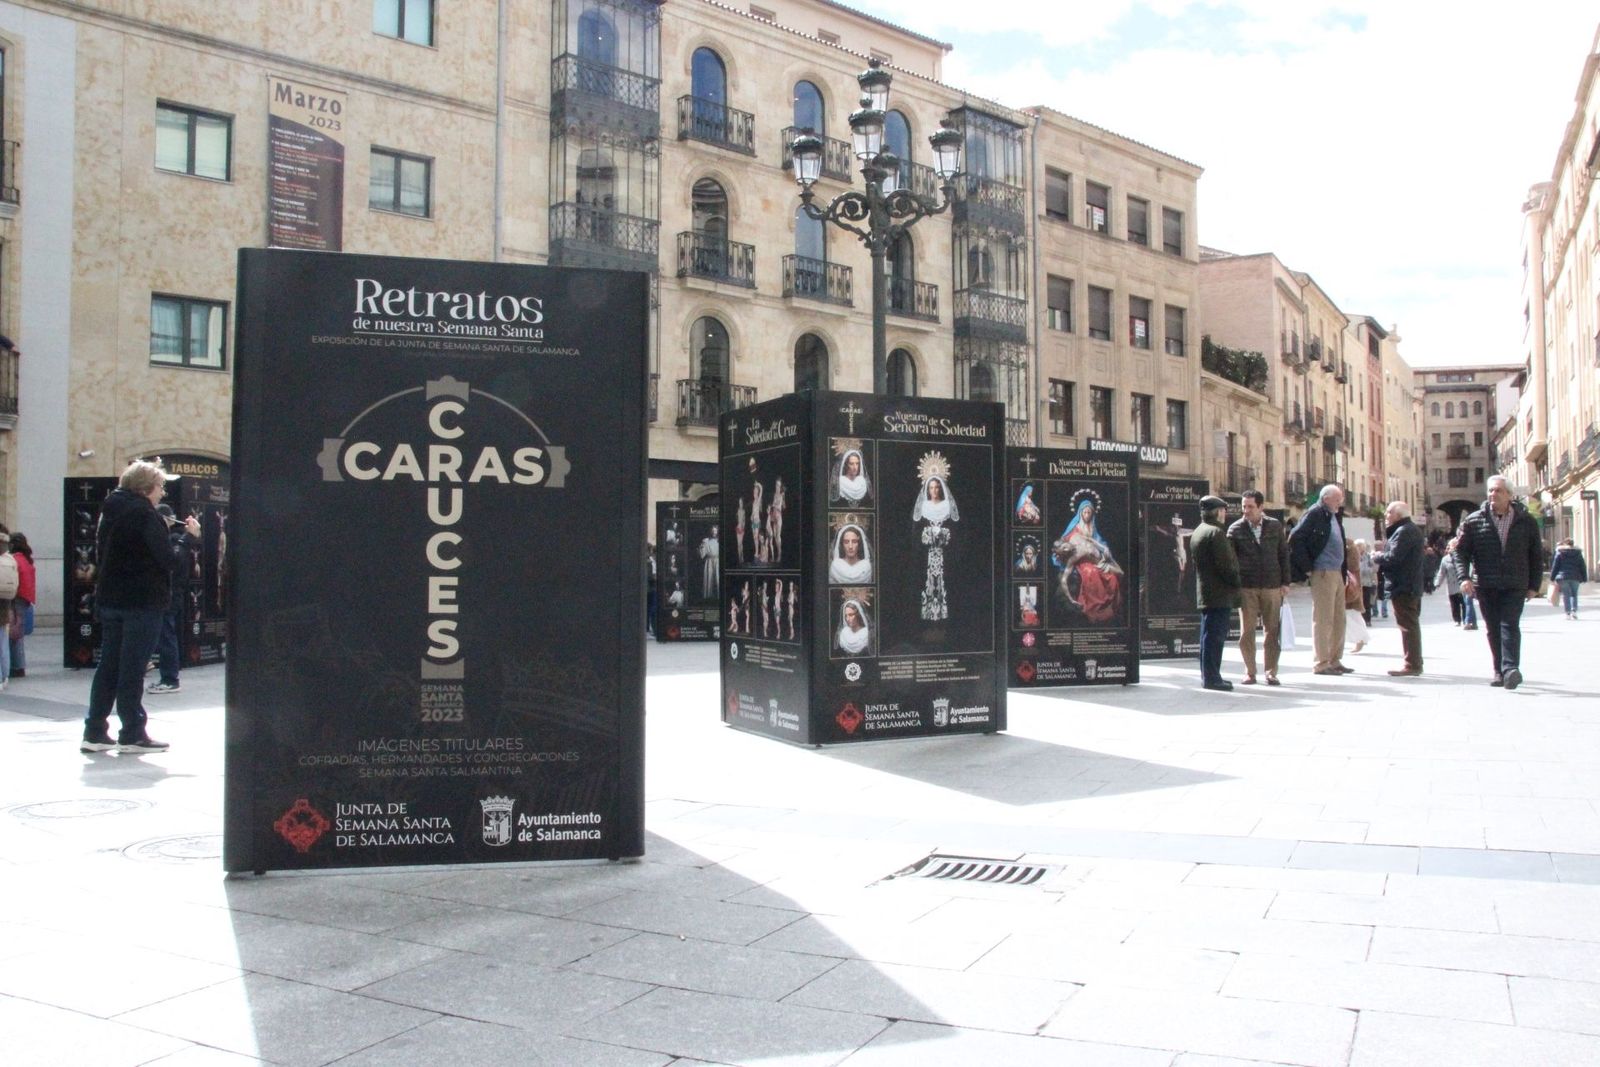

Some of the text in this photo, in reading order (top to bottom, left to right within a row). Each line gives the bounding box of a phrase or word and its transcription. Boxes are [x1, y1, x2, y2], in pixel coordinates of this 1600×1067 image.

[275, 82, 342, 115] Marzo
[309, 115, 342, 131] 2023
[354, 279, 543, 324] Retratos
[353, 317, 544, 339] de nuestra Semana Santa
[312, 335, 367, 345] EXPOSICIÓN
[385, 339, 395, 347] LA
[399, 340, 427, 348] JUNTA
[429, 341, 441, 349] DE
[442, 342, 480, 351] SEMANA
[482, 343, 511, 352] SANTA
[513, 345, 524, 353] DE
[526, 346, 580, 356] SALAMANCA
[940, 418, 986, 437] Soledad
[1141, 446, 1168, 463] CALCO
[171, 463, 218, 474] TABACOS
[344, 441, 545, 485] CARAS
[421, 709, 464, 722] 2023
[865, 711, 920, 721] SEMANA SANTA
[959, 715, 989, 724] Salamanca
[865, 720, 922, 730] DE SALAMANCA
[358, 737, 524, 752] IMÁGENES TITULARES
[372, 754, 463, 765] HERMANDADES
[466, 753, 471, 762] Y
[359, 766, 522, 778] SEMANA SANTA SALMANTINA
[335, 803, 407, 818] JUNTA DE
[335, 817, 451, 831] SEMANA SANTA
[518, 812, 602, 828] Ayuntamiento
[336, 832, 455, 847] DE SALAMANCA
[518, 828, 601, 842] de Salamanca
